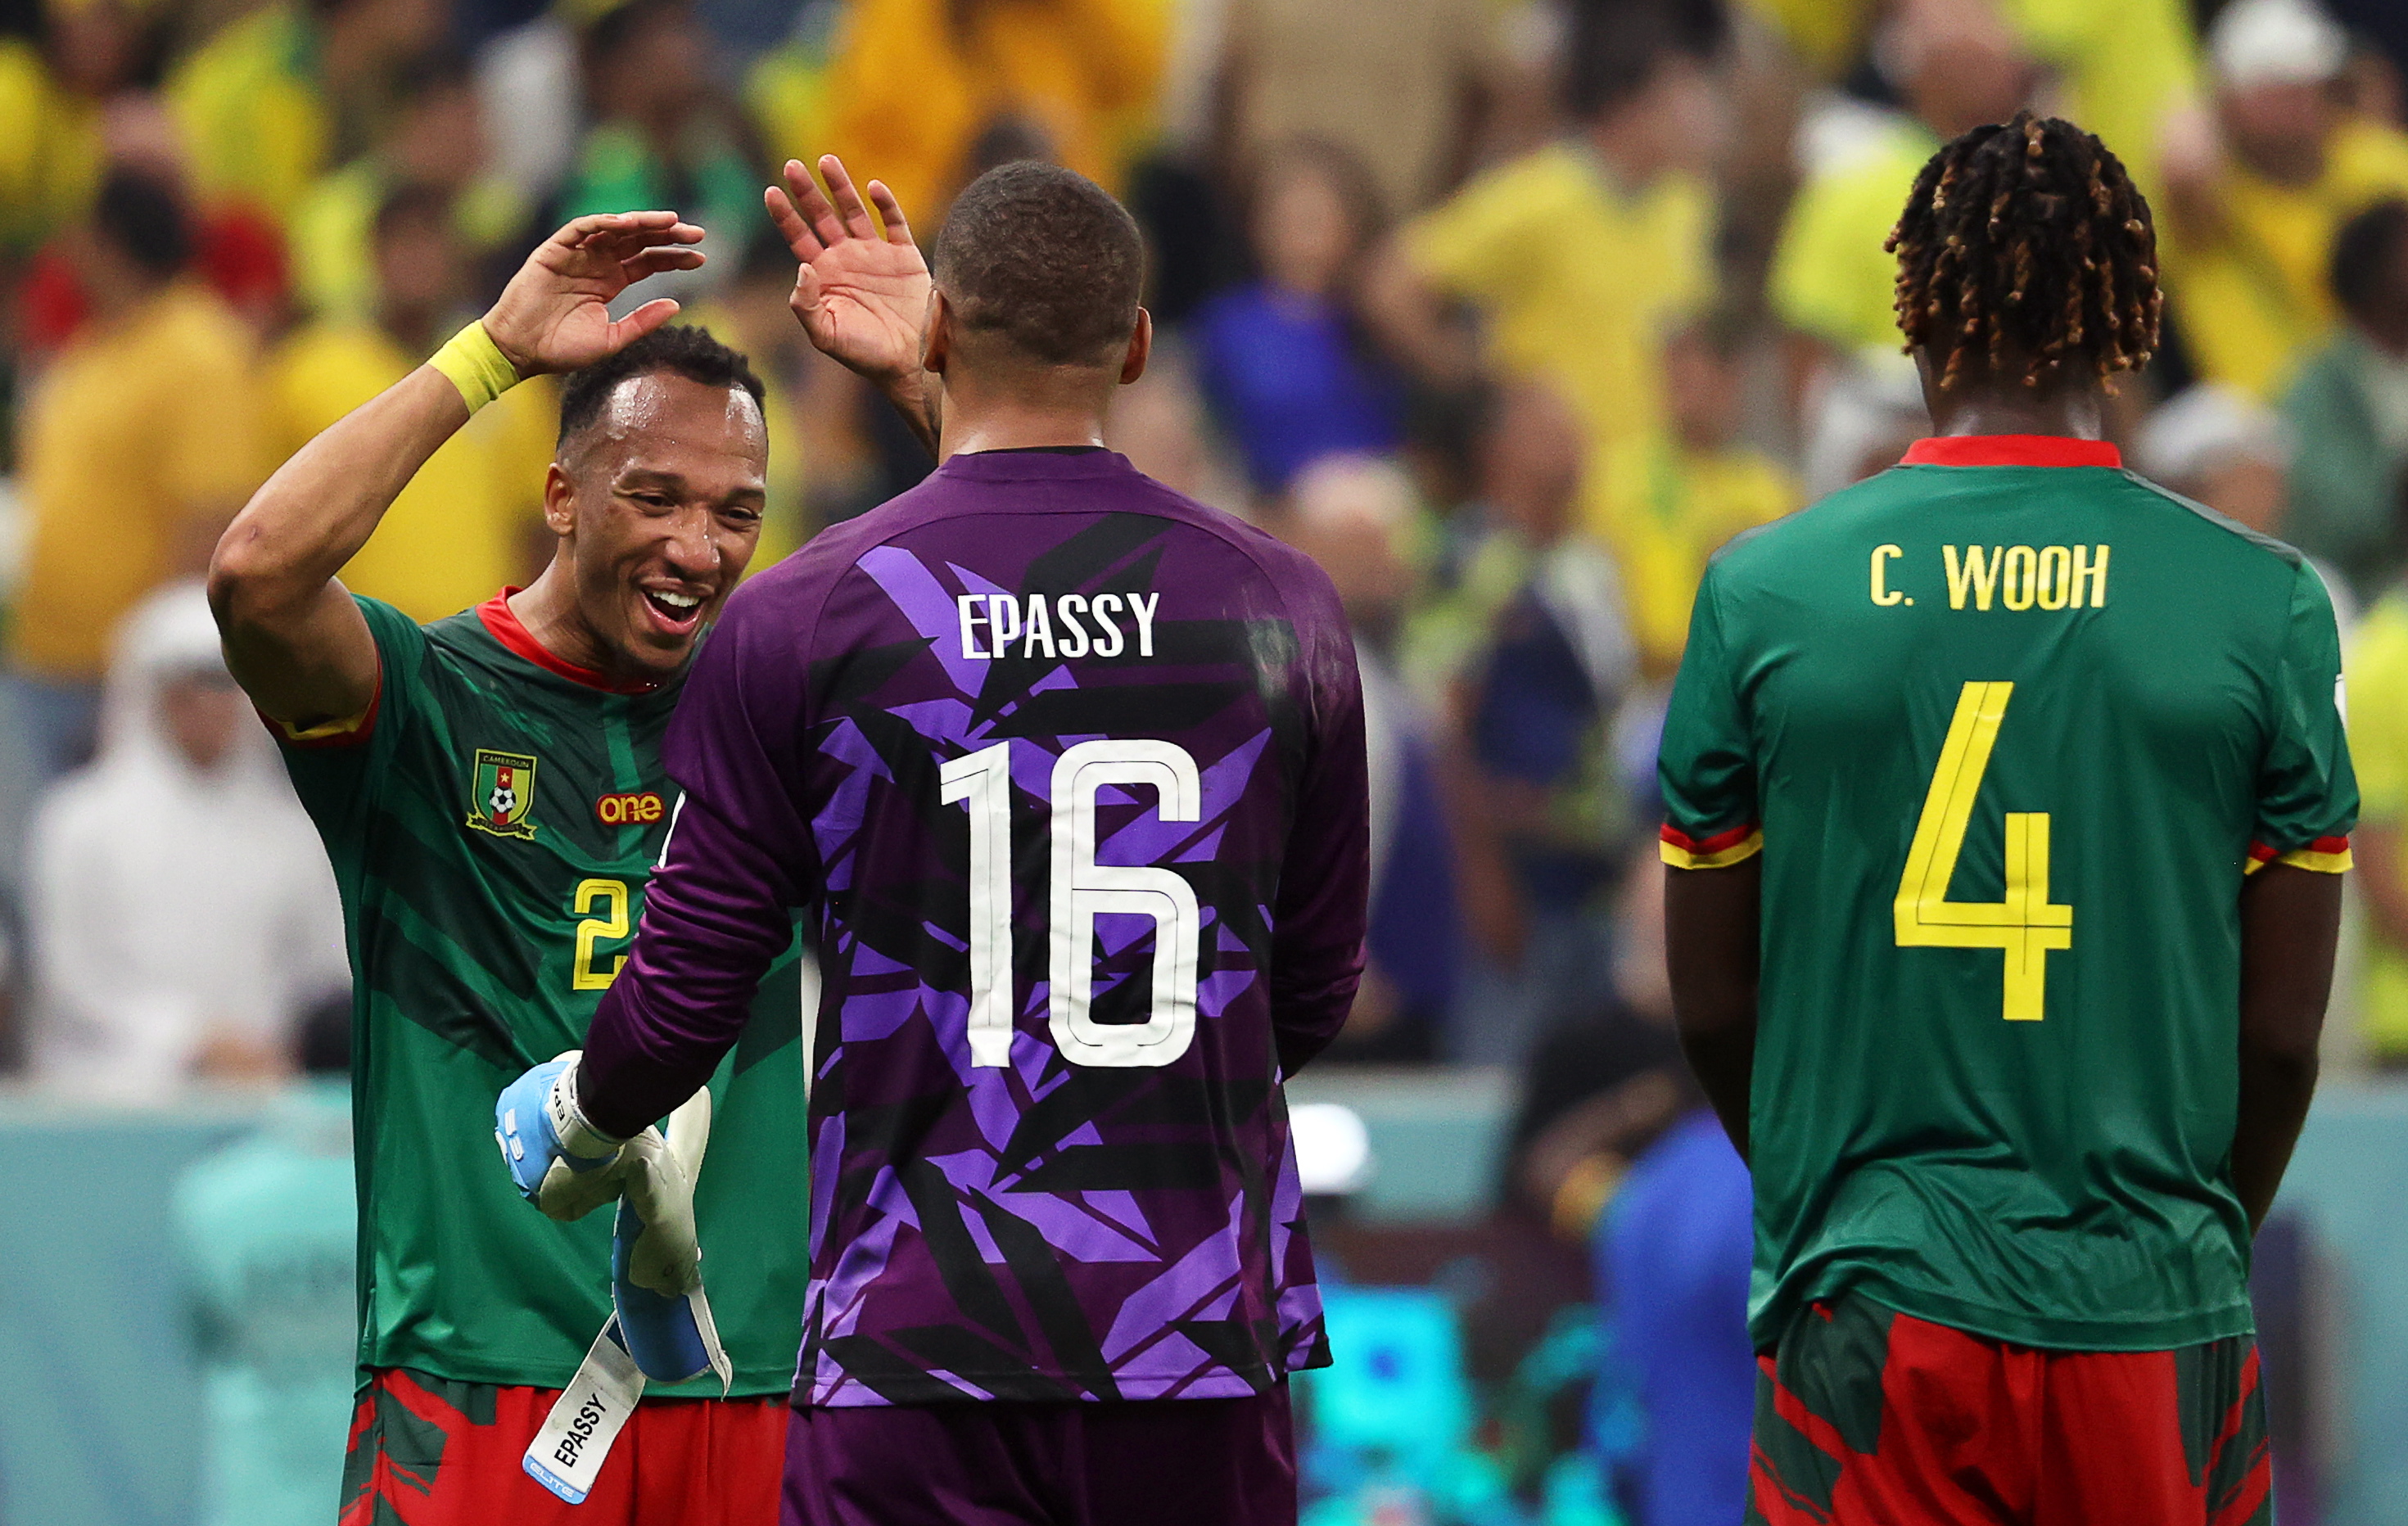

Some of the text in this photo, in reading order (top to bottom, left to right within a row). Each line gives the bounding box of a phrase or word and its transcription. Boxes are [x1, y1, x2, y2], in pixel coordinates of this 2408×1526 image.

[1870, 544, 2110, 612] C. WOOH
[957, 592, 1160, 660] EPASSY
[483, 755, 529, 768] CAMEROUN
[599, 794, 662, 823] one
[1894, 680, 2073, 1022] 4
[940, 738, 1201, 1068] 16
[553, 1392, 607, 1468] EPASSY
[529, 1461, 575, 1498] ELITE
